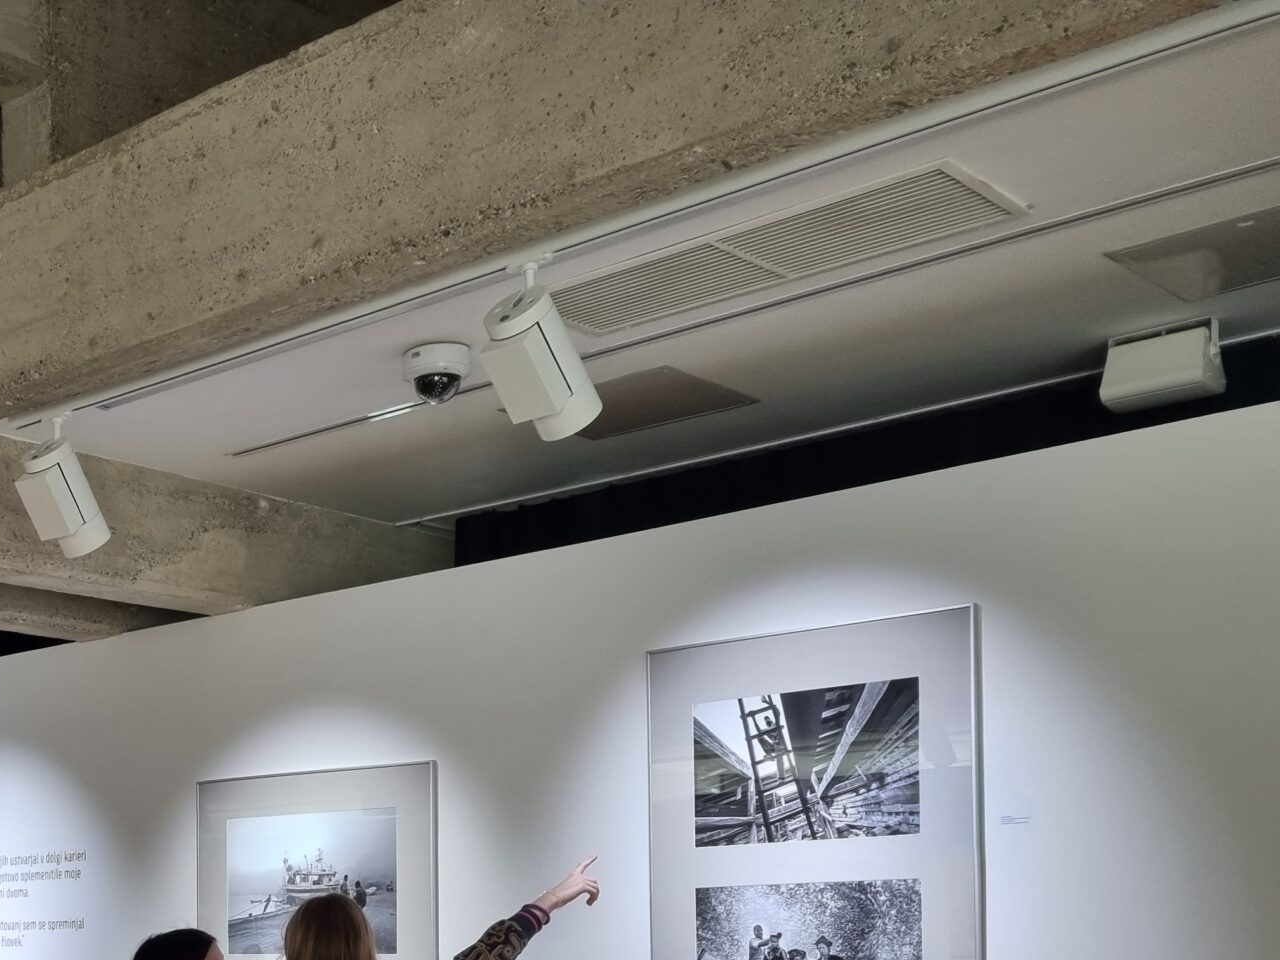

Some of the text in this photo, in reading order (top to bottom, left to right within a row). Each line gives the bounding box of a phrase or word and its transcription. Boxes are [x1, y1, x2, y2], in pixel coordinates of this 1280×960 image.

[0, 855, 9, 868] jih
[10, 852, 39, 867] ustvarjal
[46, 852, 63, 865] dolgi
[65, 850, 87, 862] karieri
[21, 869, 62, 882] oplemenitile
[64, 868, 82, 880] moje
[0, 888, 5, 898] ni
[7, 887, 30, 898] dvoma.
[23, 920, 37, 930] sem
[39, 920, 47, 930] se
[48, 917, 85, 931] spreminjal
